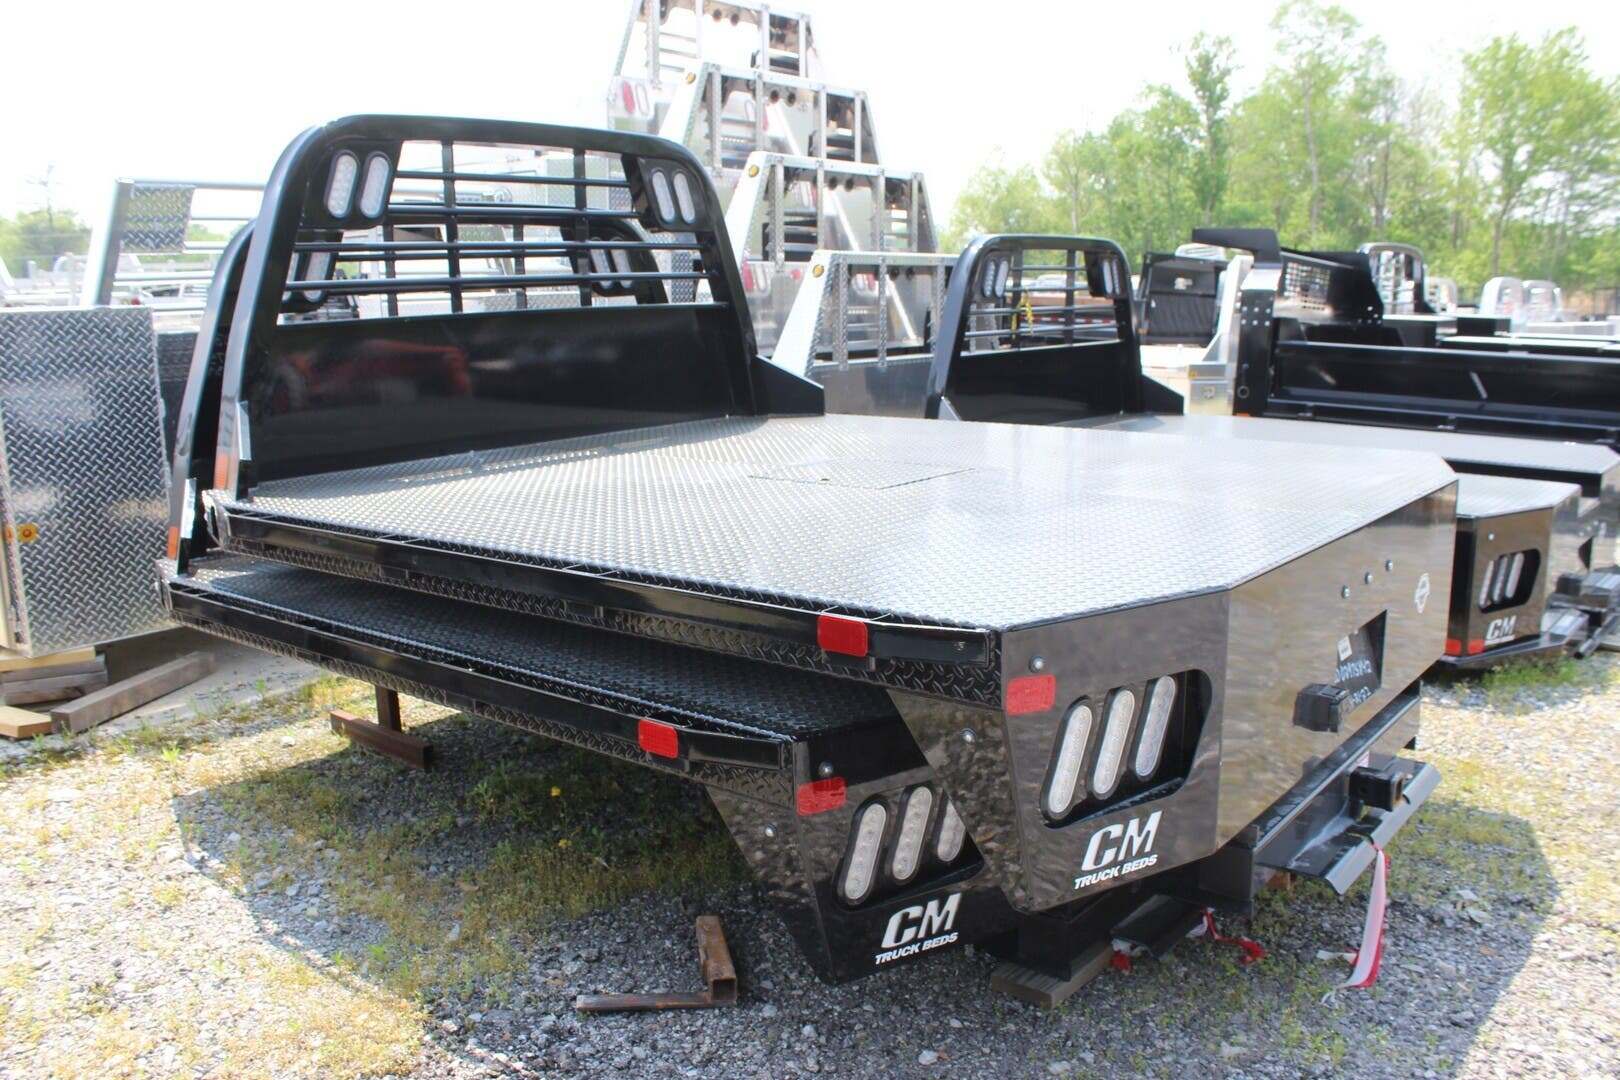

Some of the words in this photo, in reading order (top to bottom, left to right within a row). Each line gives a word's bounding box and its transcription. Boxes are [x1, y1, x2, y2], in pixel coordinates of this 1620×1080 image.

[1486, 615, 1517, 640] CM
[1081, 810, 1163, 871] CM
[1074, 865, 1120, 890] TRUCK
[1121, 854, 1158, 875] BEDS
[881, 892, 962, 948] CM
[875, 942, 921, 965] TRUCK
[921, 932, 959, 951] BEDS
